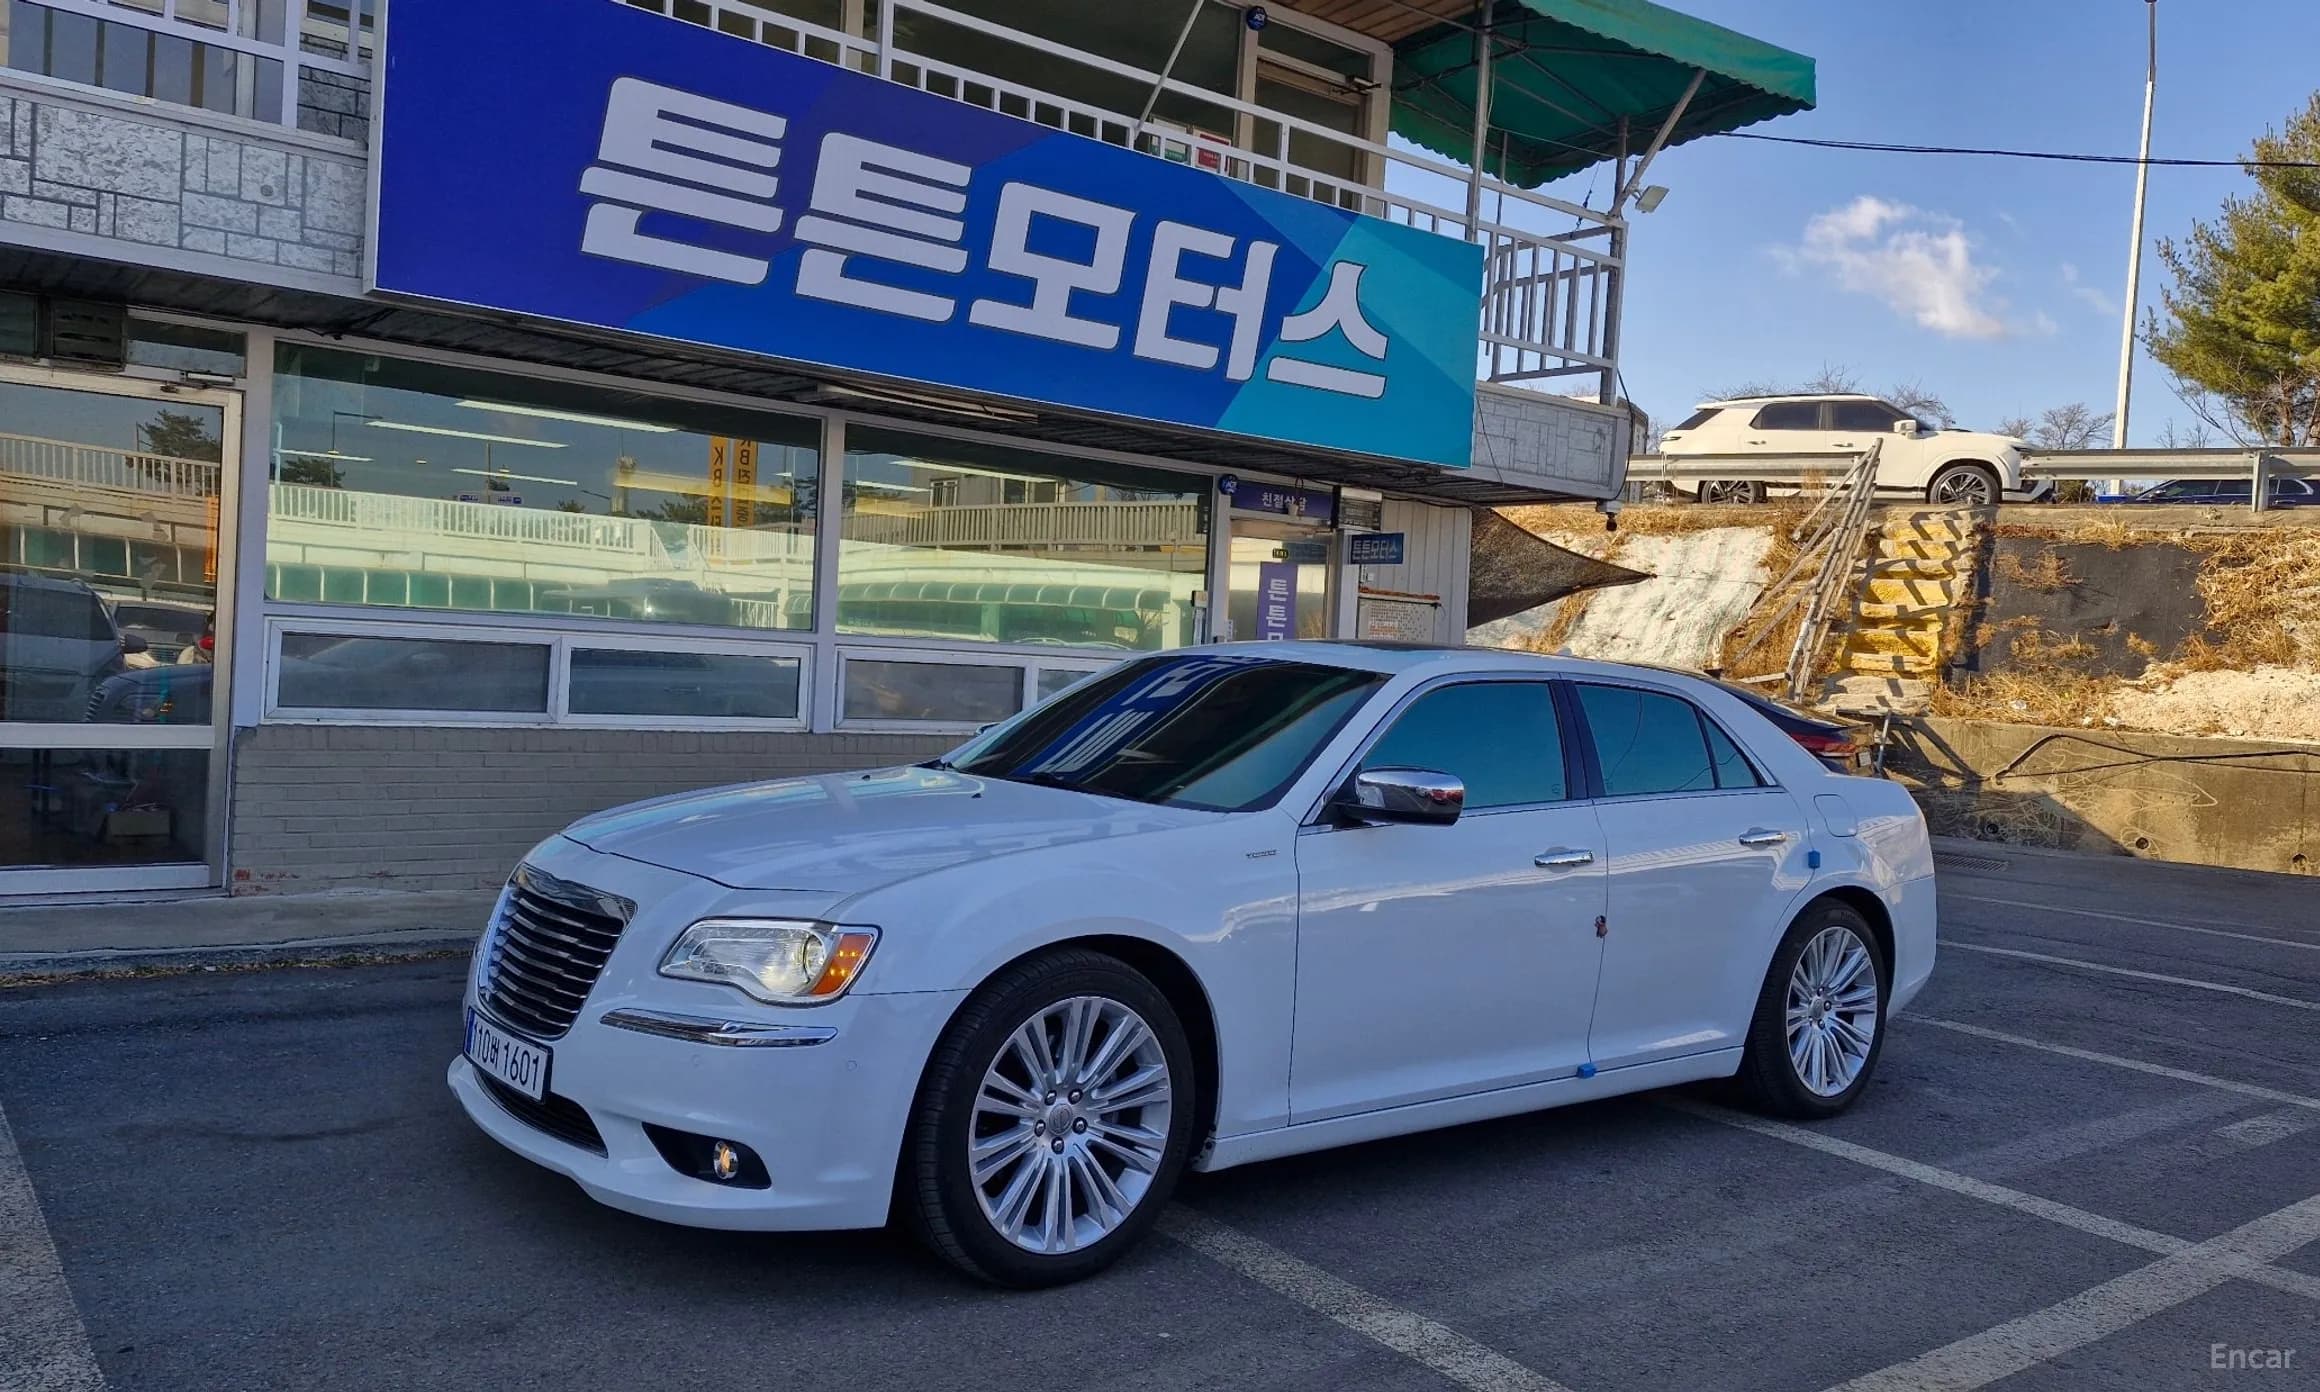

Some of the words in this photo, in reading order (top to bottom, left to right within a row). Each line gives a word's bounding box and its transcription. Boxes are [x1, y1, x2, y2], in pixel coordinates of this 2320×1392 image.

[579, 76, 1388, 399] 튼튼모터스
[1352, 540, 1398, 560] 튼튼모터스
[504, 1041, 540, 1092] 1601
